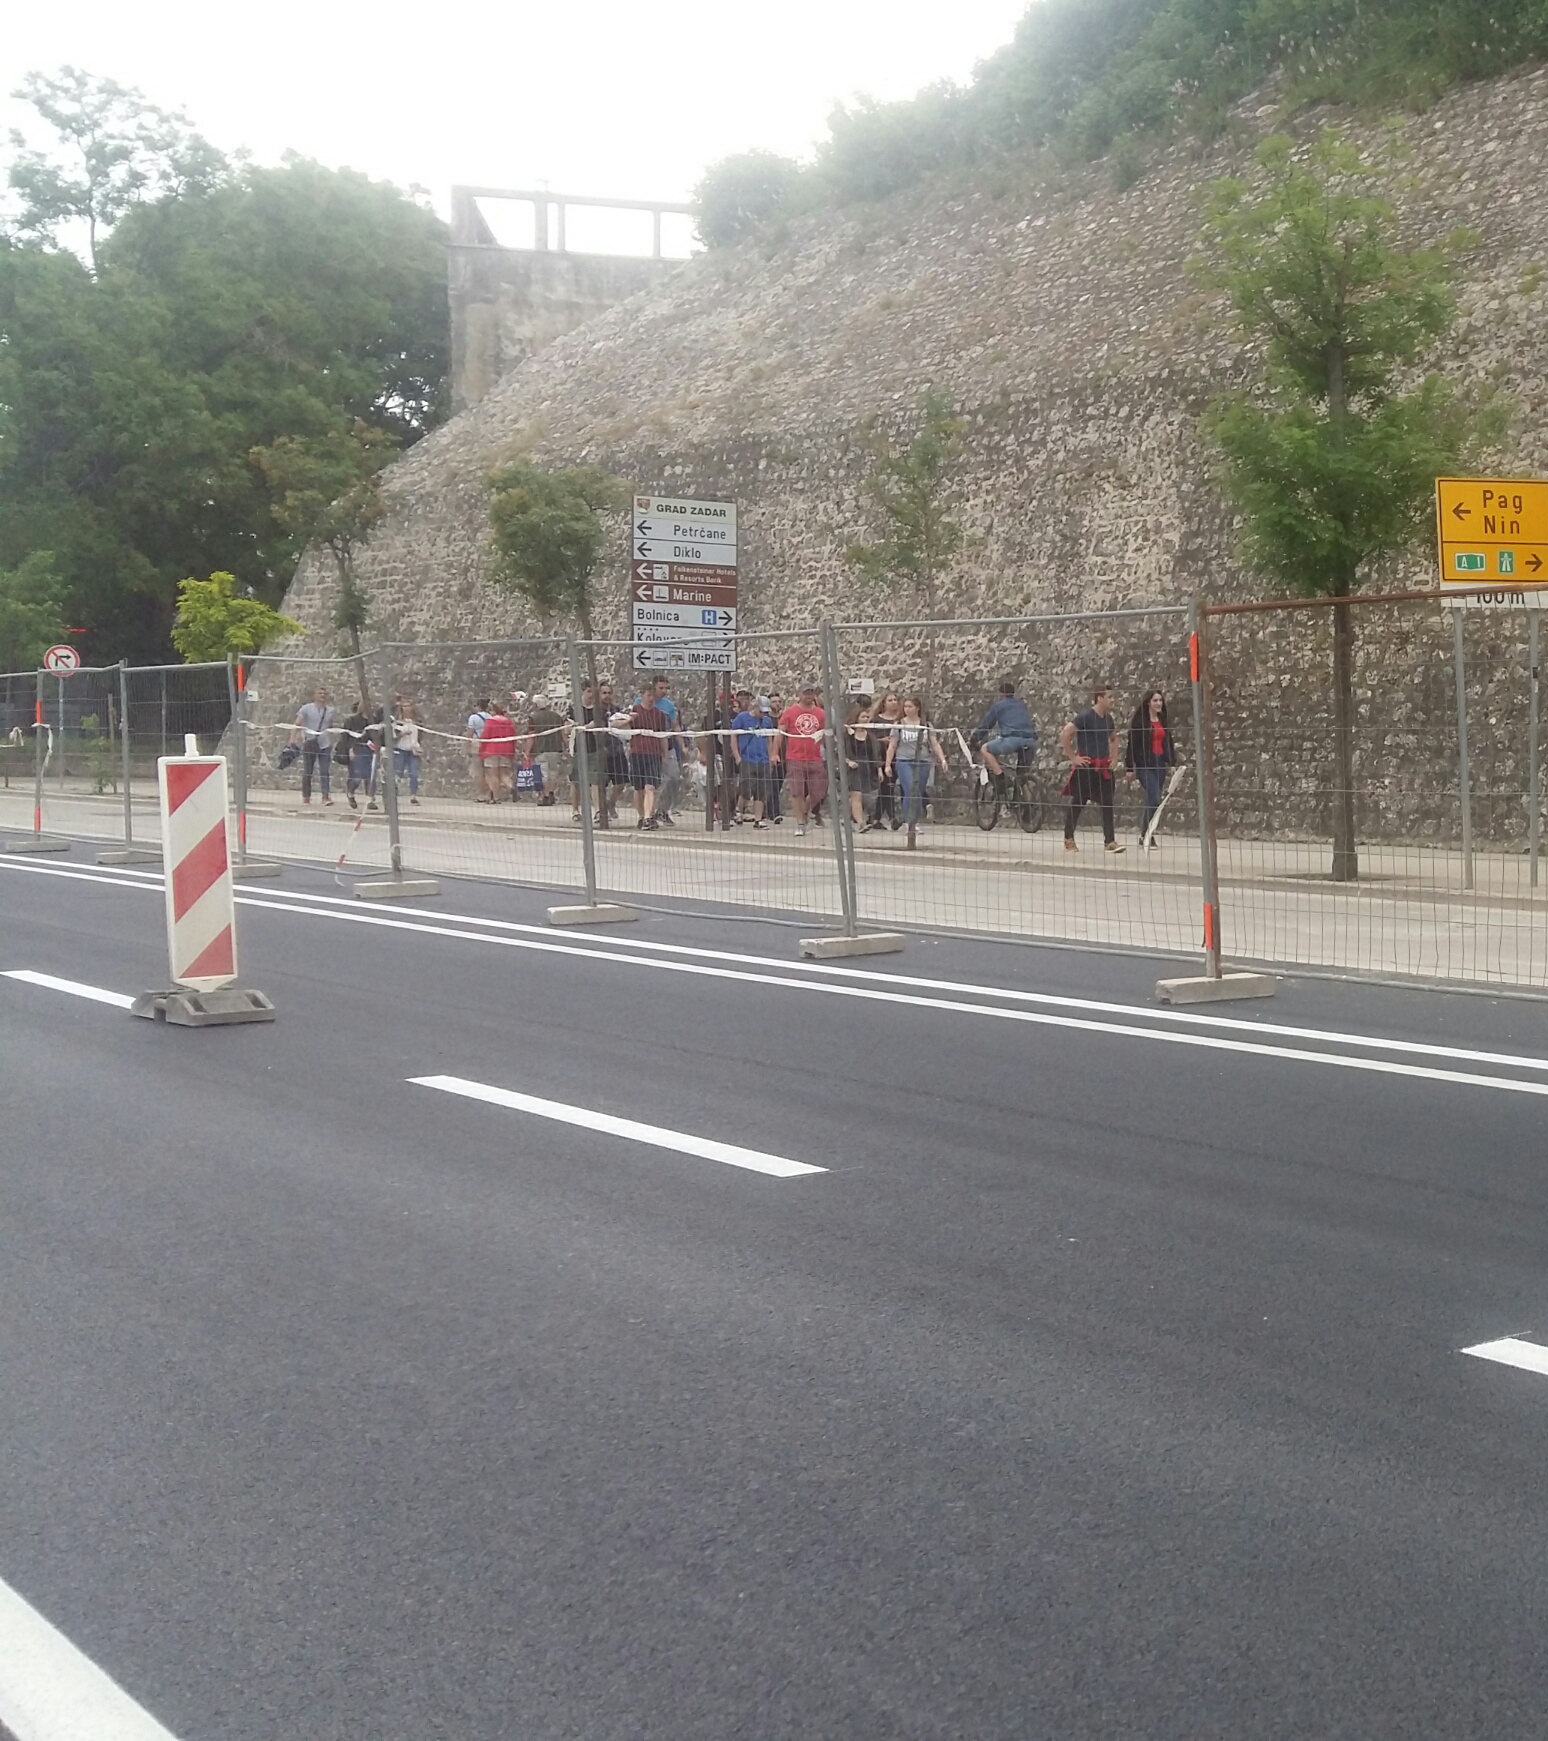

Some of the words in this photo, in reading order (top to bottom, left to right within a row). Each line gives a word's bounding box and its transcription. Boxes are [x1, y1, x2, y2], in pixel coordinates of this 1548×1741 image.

[1482, 489, 1523, 514] Pag
[656, 504, 687, 514] GRAD
[690, 506, 727, 518] ZADAR
[1484, 515, 1520, 534] Nin
[673, 524, 727, 540] Petrčane
[673, 546, 702, 559] Diklo
[680, 574, 705, 583] Resorts
[716, 568, 737, 576] Hotels
[673, 588, 712, 603] Marine
[1510, 592, 1525, 604] m
[637, 608, 680, 622] Bolnica
[688, 653, 732, 665] IM:PACT
